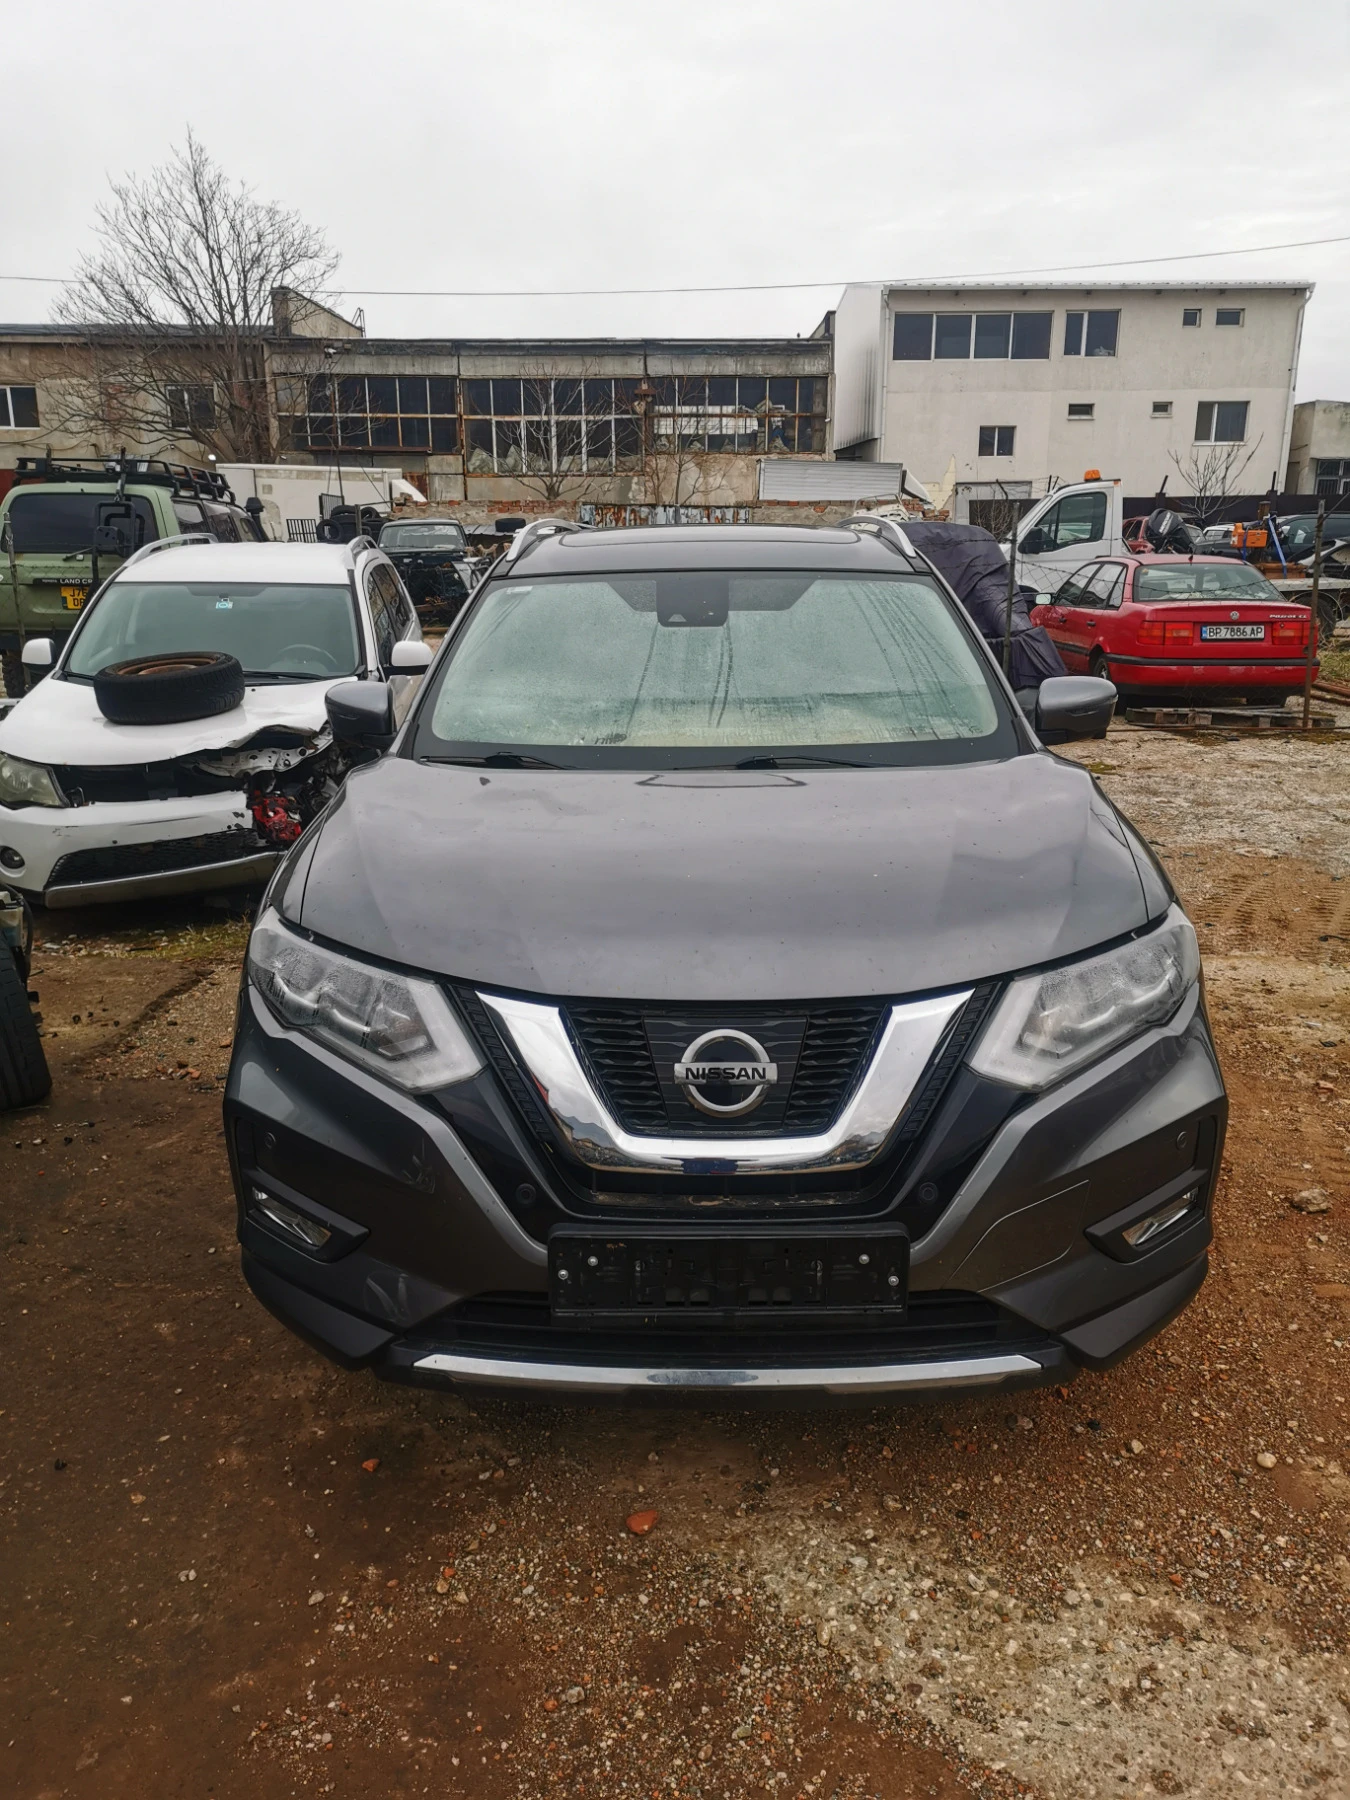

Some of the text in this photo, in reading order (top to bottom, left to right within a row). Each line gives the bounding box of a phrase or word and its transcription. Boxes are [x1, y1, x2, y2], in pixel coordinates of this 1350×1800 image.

[1208, 626, 1263, 637] BP 7886 AP
[685, 1067, 767, 1080] NISSAN
